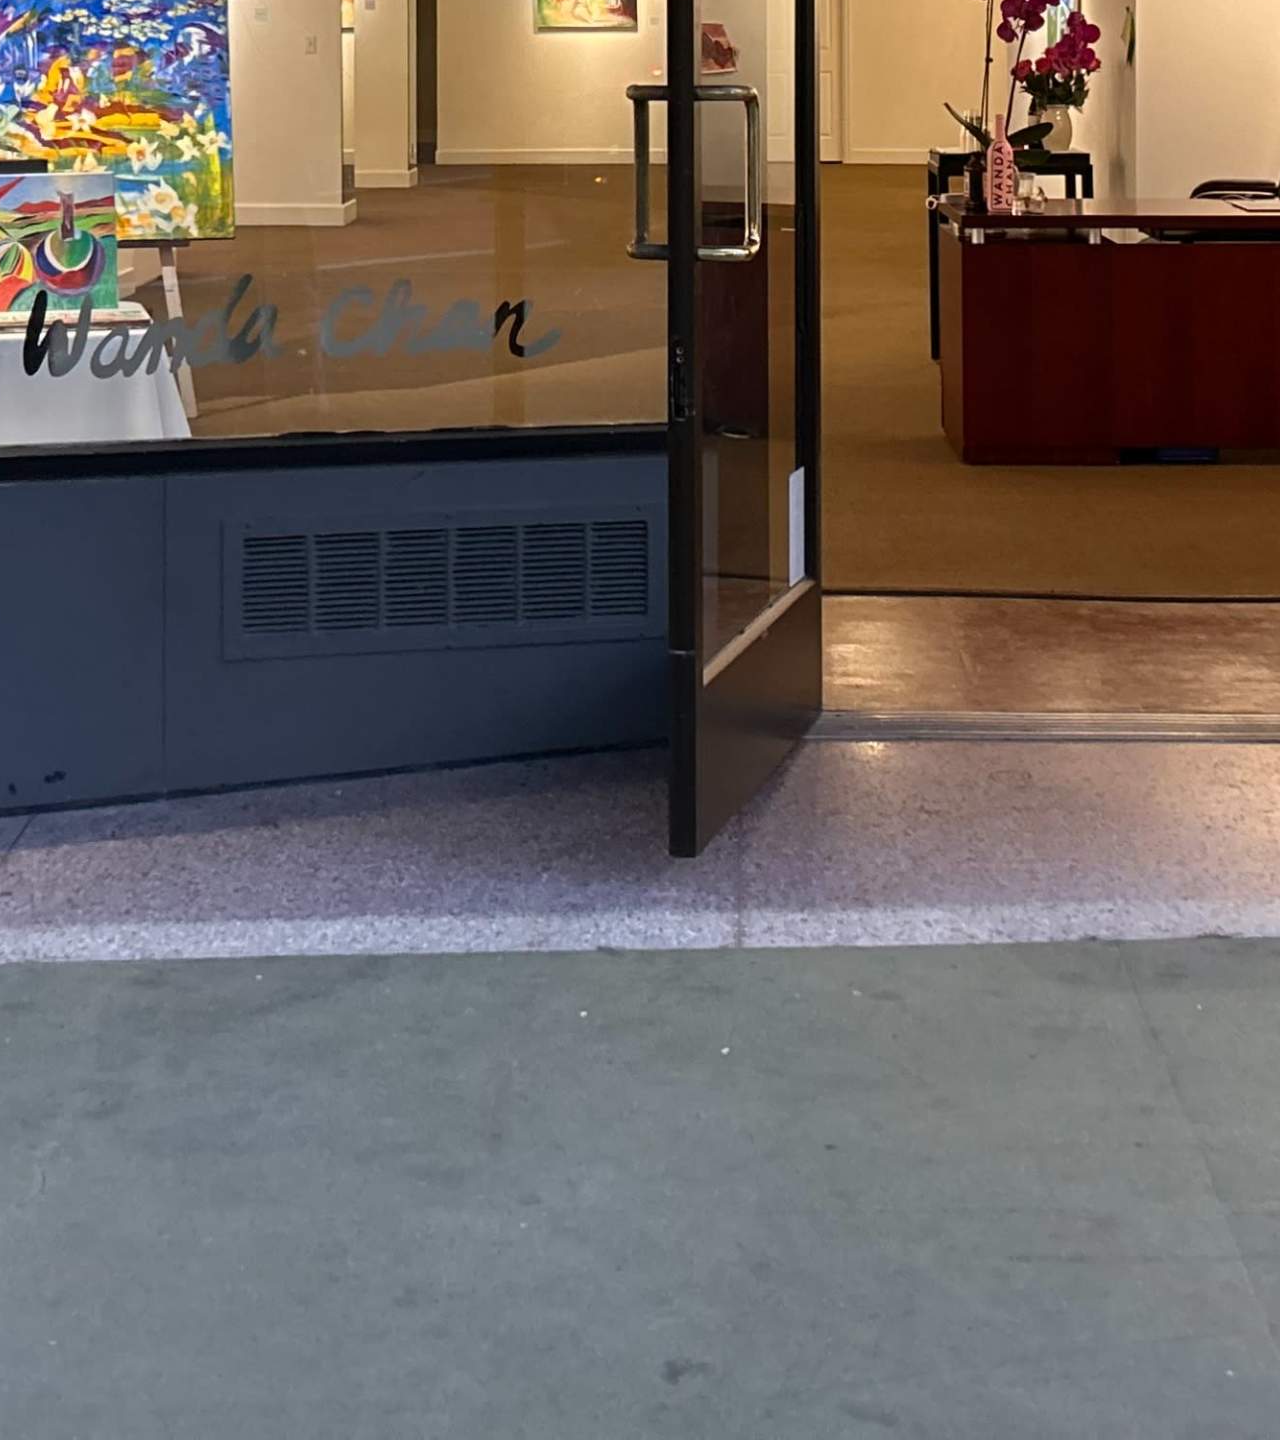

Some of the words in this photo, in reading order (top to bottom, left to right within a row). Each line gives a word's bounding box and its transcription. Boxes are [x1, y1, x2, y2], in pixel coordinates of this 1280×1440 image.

[993, 145, 1004, 206] WANDA
[22, 273, 282, 380] Wanda
[323, 278, 562, 358] Chan
